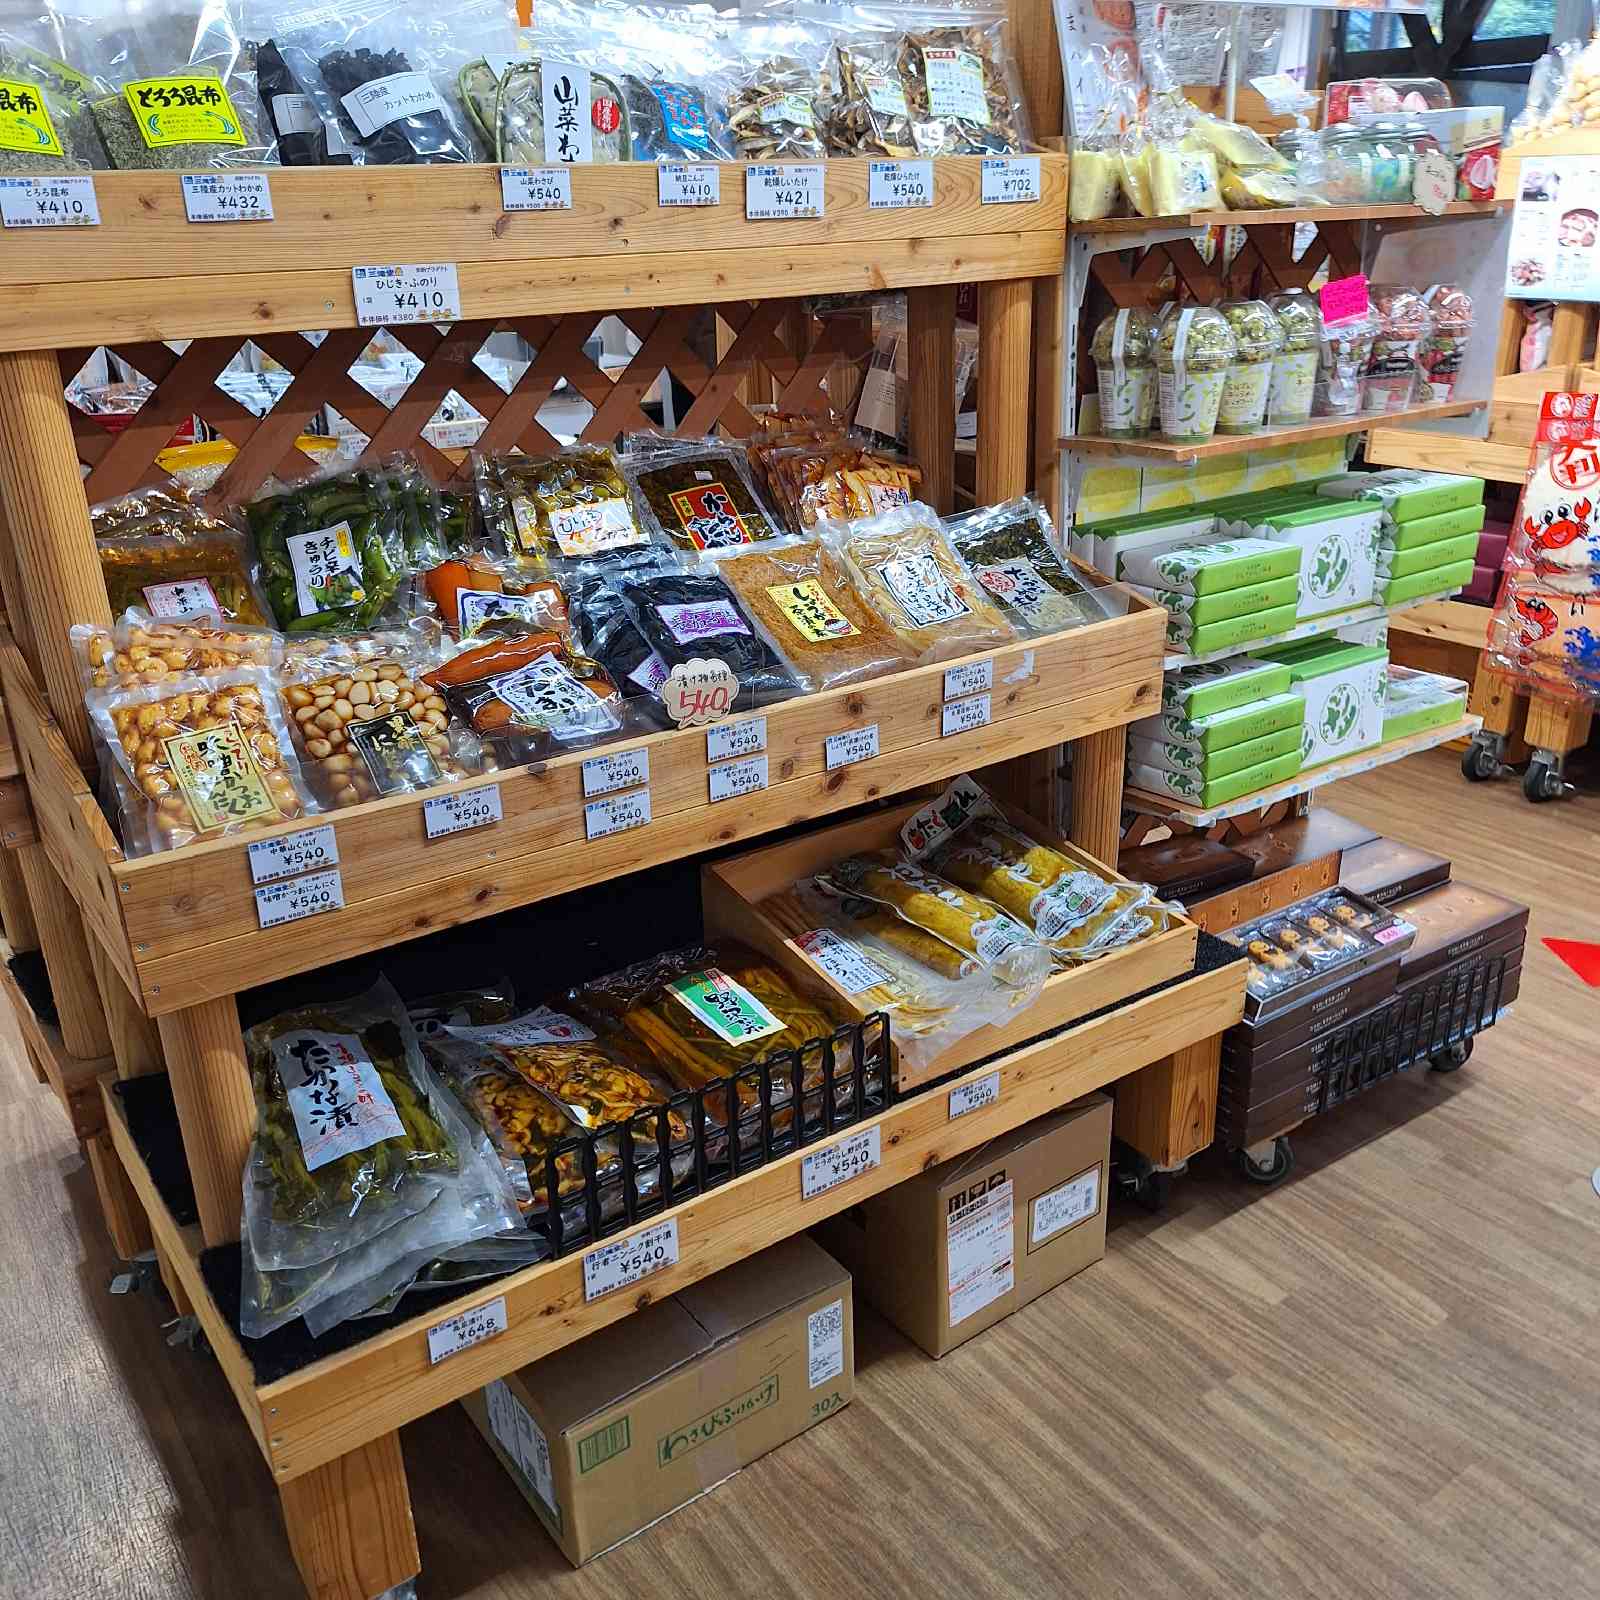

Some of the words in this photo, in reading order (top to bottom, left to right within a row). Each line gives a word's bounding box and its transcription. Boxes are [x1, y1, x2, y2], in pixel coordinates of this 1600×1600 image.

[137, 84, 221, 108] とろろ昆布
[553, 75, 580, 163] 山菜わ
[25, 187, 69, 197] とろろ昆布
[191, 184, 263, 194] 三陸産カットわかめ
[681, 184, 711, 196] ¥410
[893, 183, 923, 196] ¥540
[1003, 179, 1031, 192] ¥702
[528, 187, 561, 200] ¥540
[775, 190, 810, 206] ¥421
[37, 200, 83, 214] ¥410
[217, 195, 260, 209] ¥432
[375, 276, 438, 290] ひじき・ふのり
[394, 291, 444, 309] ¥410
[962, 675, 985, 688] ¥540
[960, 710, 984, 724] ¥540
[730, 735, 758, 749] ¥540
[846, 742, 871, 756] ¥540
[608, 766, 639, 781] ¥540
[732, 774, 759, 787] ¥540
[454, 805, 489, 821] ¥540
[611, 808, 642, 824] ¥540
[270, 838, 317, 855] 中華山くらげ
[284, 847, 324, 865] ¥540
[263, 880, 336, 903] 味噌かつおにんにく
[290, 891, 330, 910] ¥540
[291, 1039, 359, 1136] たかな漬
[968, 1087, 992, 1104] ¥540
[832, 1150, 869, 1174] ¥540
[620, 1246, 664, 1273] ¥540
[458, 1318, 495, 1340] ¥648
